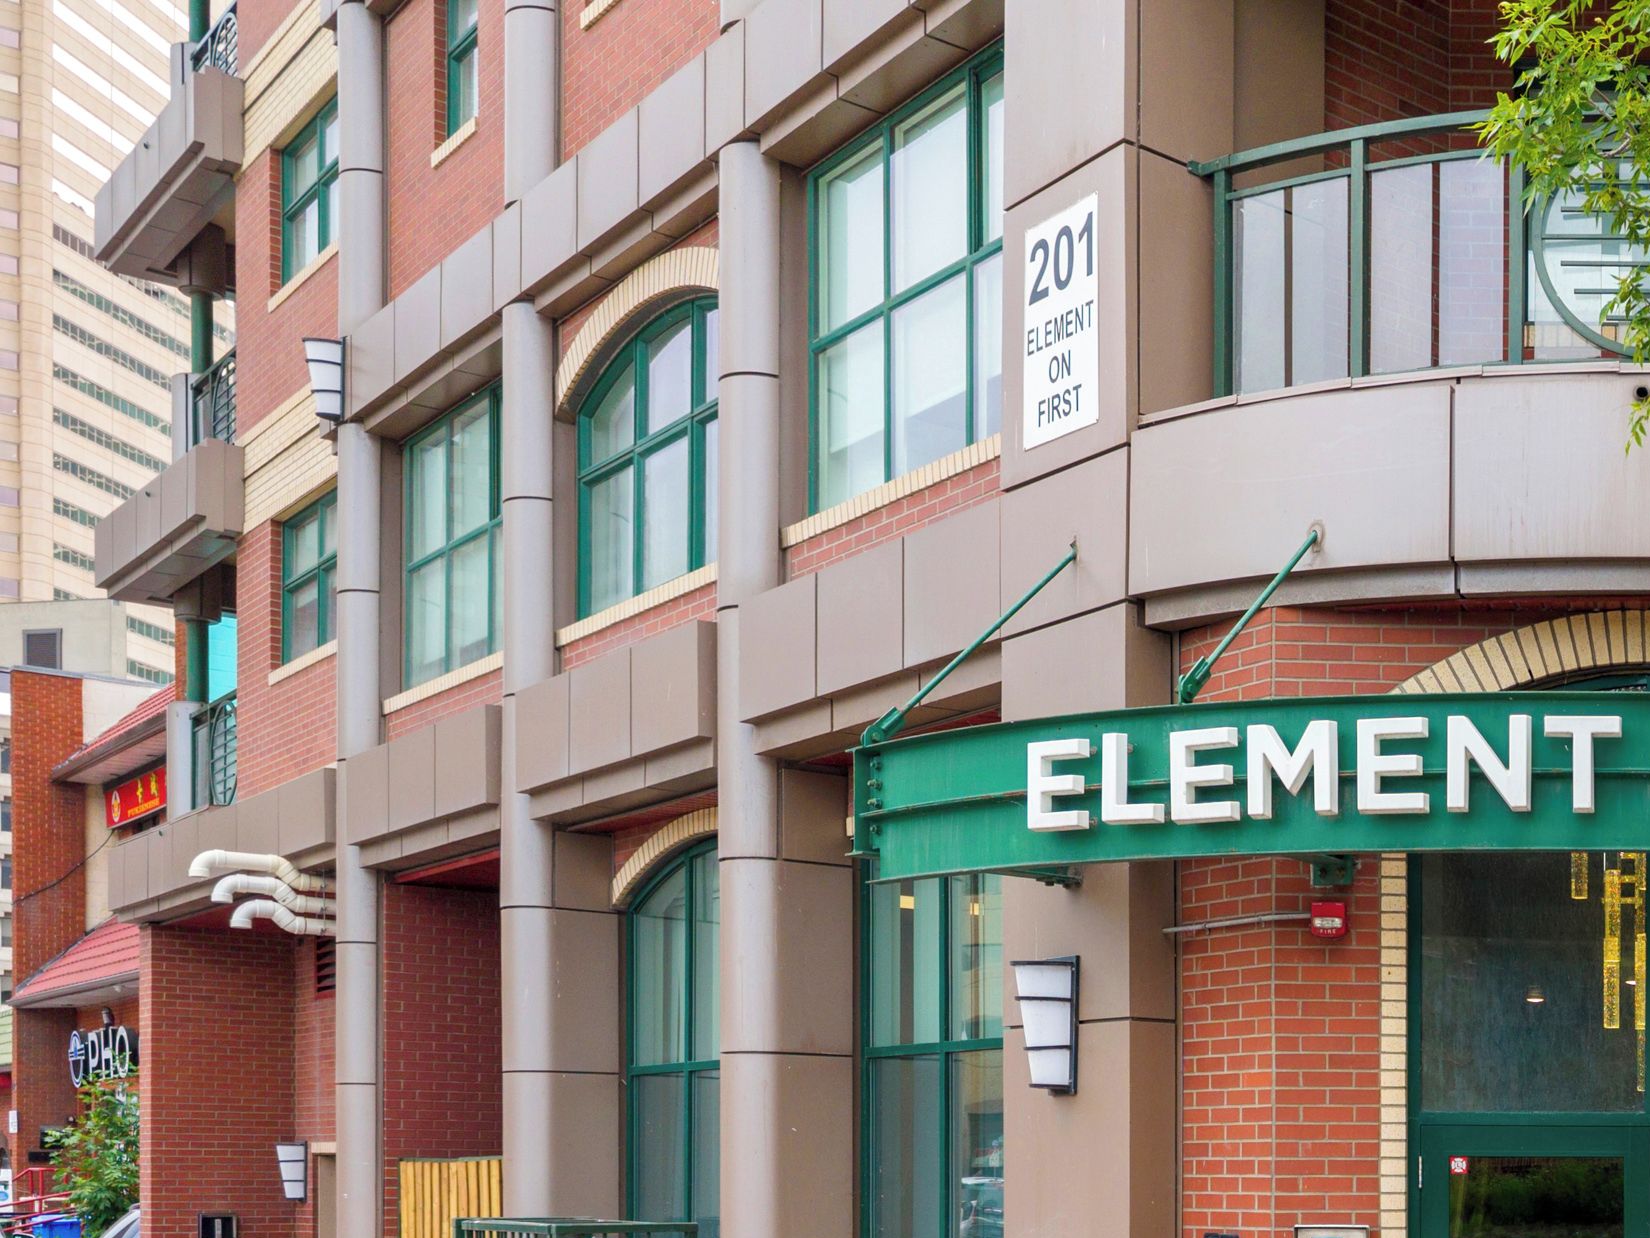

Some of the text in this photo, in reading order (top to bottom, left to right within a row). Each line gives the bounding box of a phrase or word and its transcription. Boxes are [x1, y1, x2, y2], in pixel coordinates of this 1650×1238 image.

[1028, 211, 1093, 306] 201
[1027, 299, 1094, 356] ELEMENT
[1048, 349, 1072, 384] ON
[1038, 384, 1082, 428] FIRST
[1027, 714, 1622, 832] ELEMENT
[88, 1026, 129, 1082] PHO
